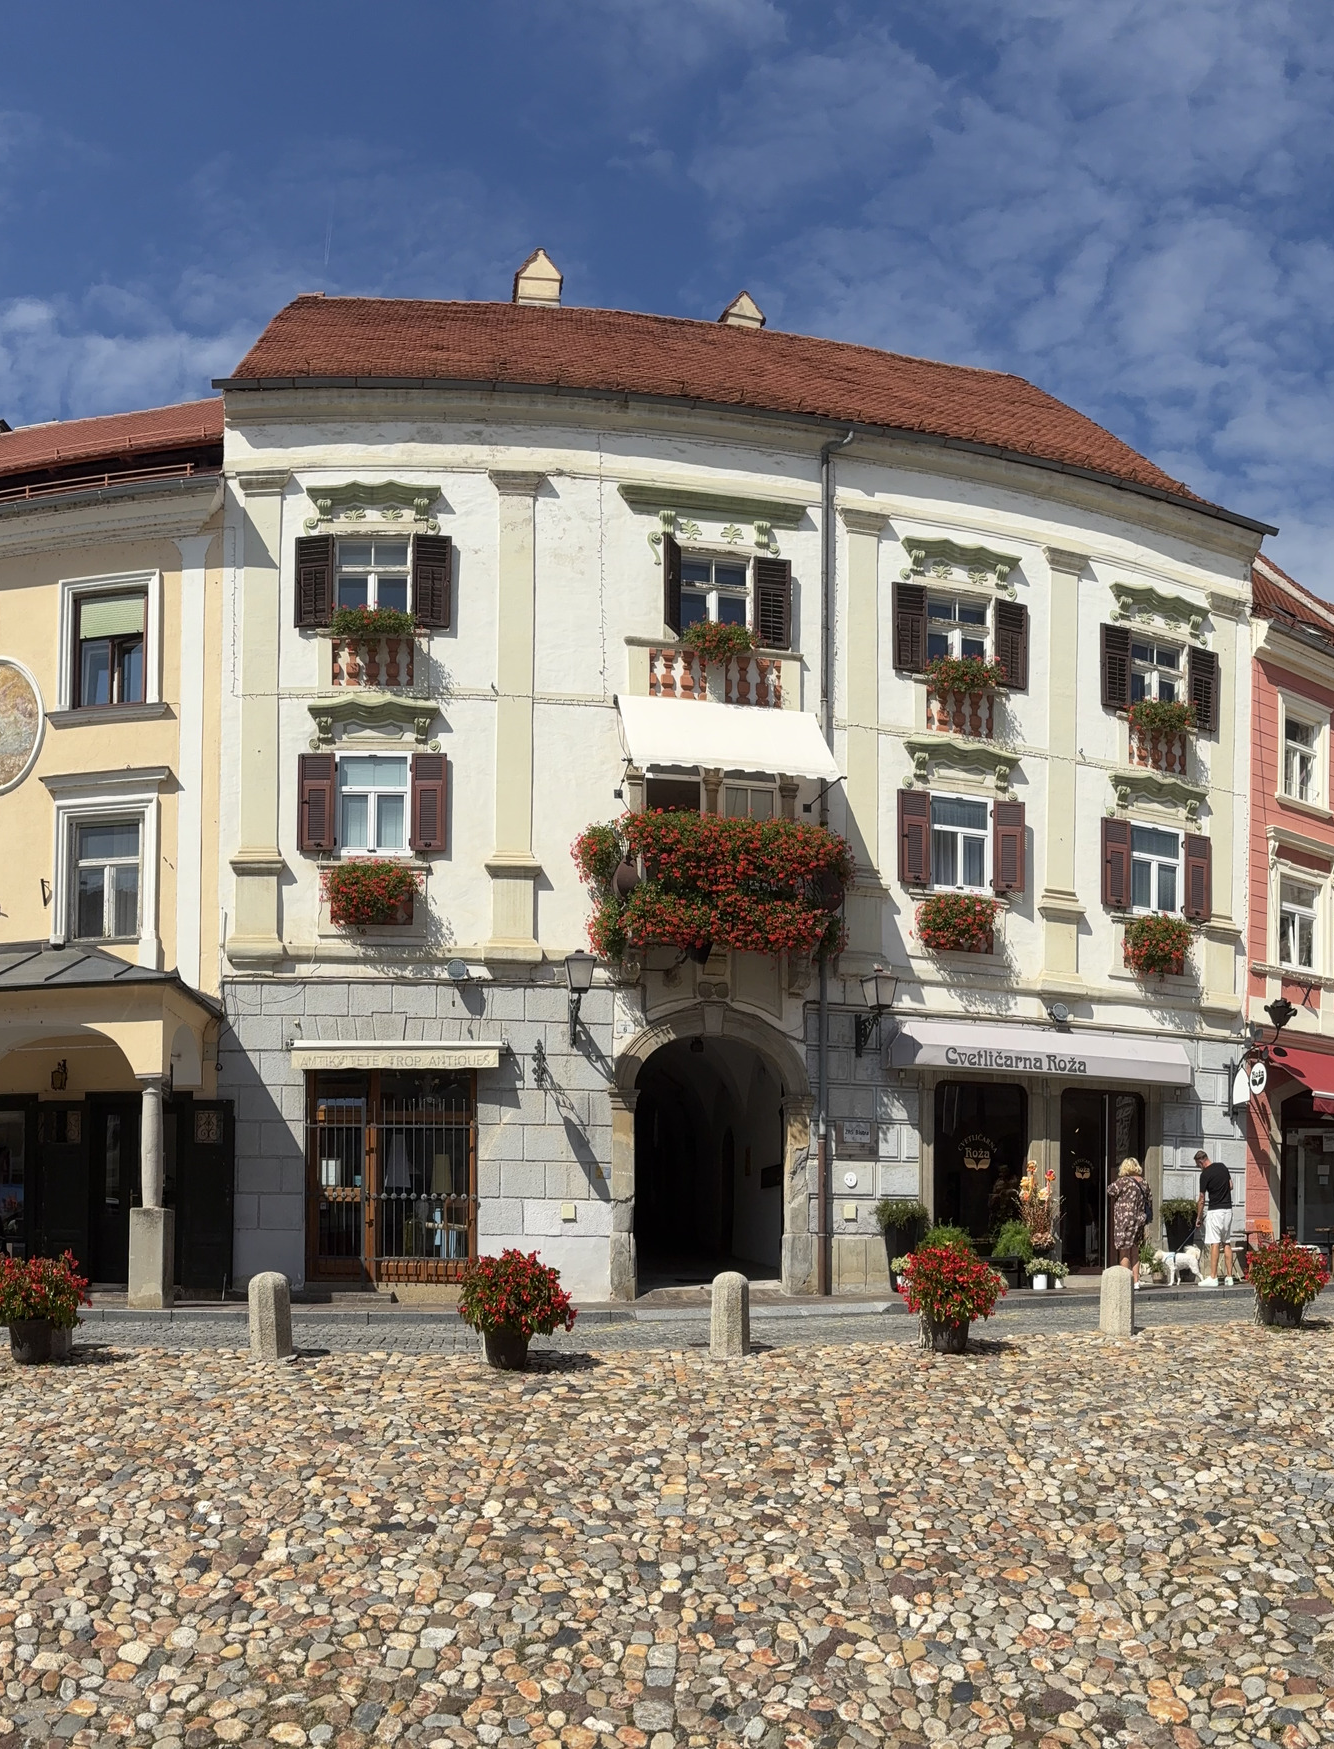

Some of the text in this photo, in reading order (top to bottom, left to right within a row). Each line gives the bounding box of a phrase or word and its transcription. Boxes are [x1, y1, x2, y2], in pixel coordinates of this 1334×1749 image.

[429, 1055, 491, 1067] ANTIQUES
[945, 1046, 1087, 1074] Cvetličarna Roža
[958, 1133, 998, 1154] CVETLIČARNA
[965, 1147, 990, 1159] Roža
